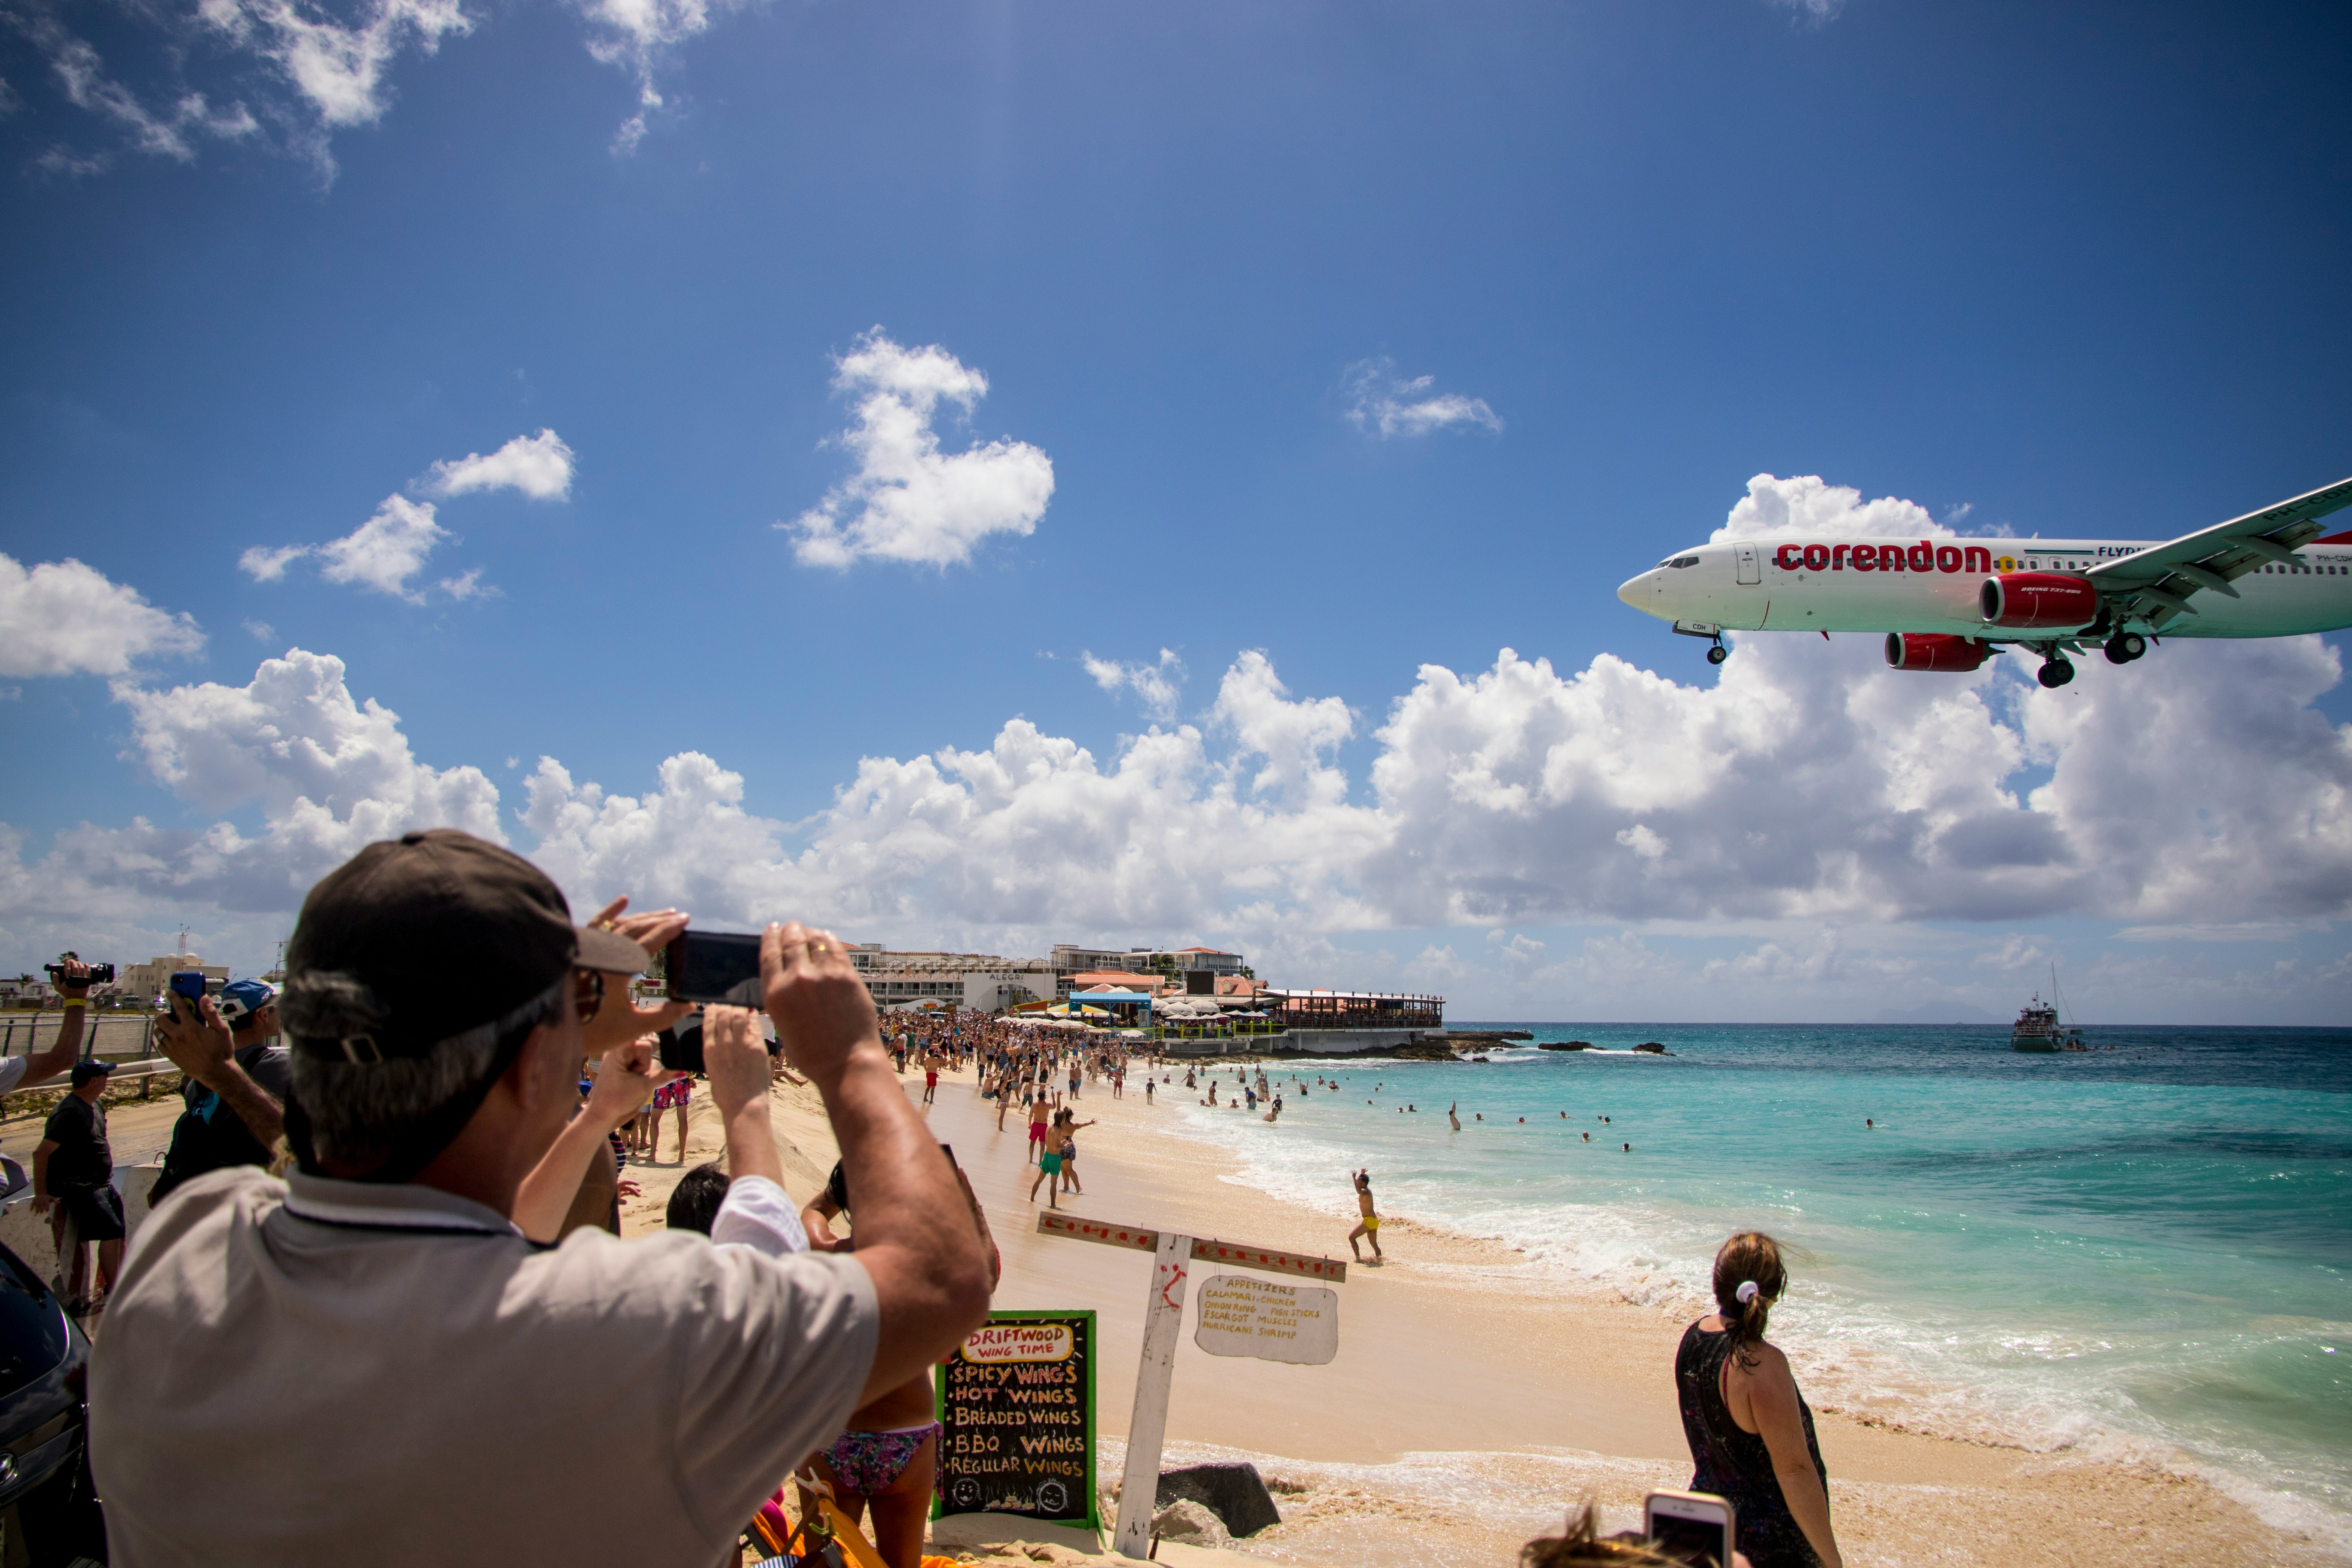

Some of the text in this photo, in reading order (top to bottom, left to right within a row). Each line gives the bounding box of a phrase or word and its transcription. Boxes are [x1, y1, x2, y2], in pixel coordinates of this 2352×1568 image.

[1776, 540, 1991, 573] corendon
[2098, 547, 2145, 557] FLYD
[1227, 1279, 1296, 1295] APPETIZERS
[1206, 1290, 1296, 1307] CALAMARI CHICKEN
[1204, 1301, 1231, 1309] ONION
[1233, 1302, 1256, 1313] RING
[1291, 1309, 1320, 1318] STICKS
[1204, 1310, 1297, 1326] ESCARGOT MUSCLES
[968, 1327, 1064, 1346] DRIFTWOOD
[1202, 1321, 1296, 1339] HURRICANE SHRIMP
[977, 1343, 1054, 1357] WING TIME
[956, 1386, 998, 1401] HOT
[955, 1407, 1026, 1426] BREADED
[956, 1435, 999, 1453] BBQ
[951, 1457, 1020, 1474] REGULAR
